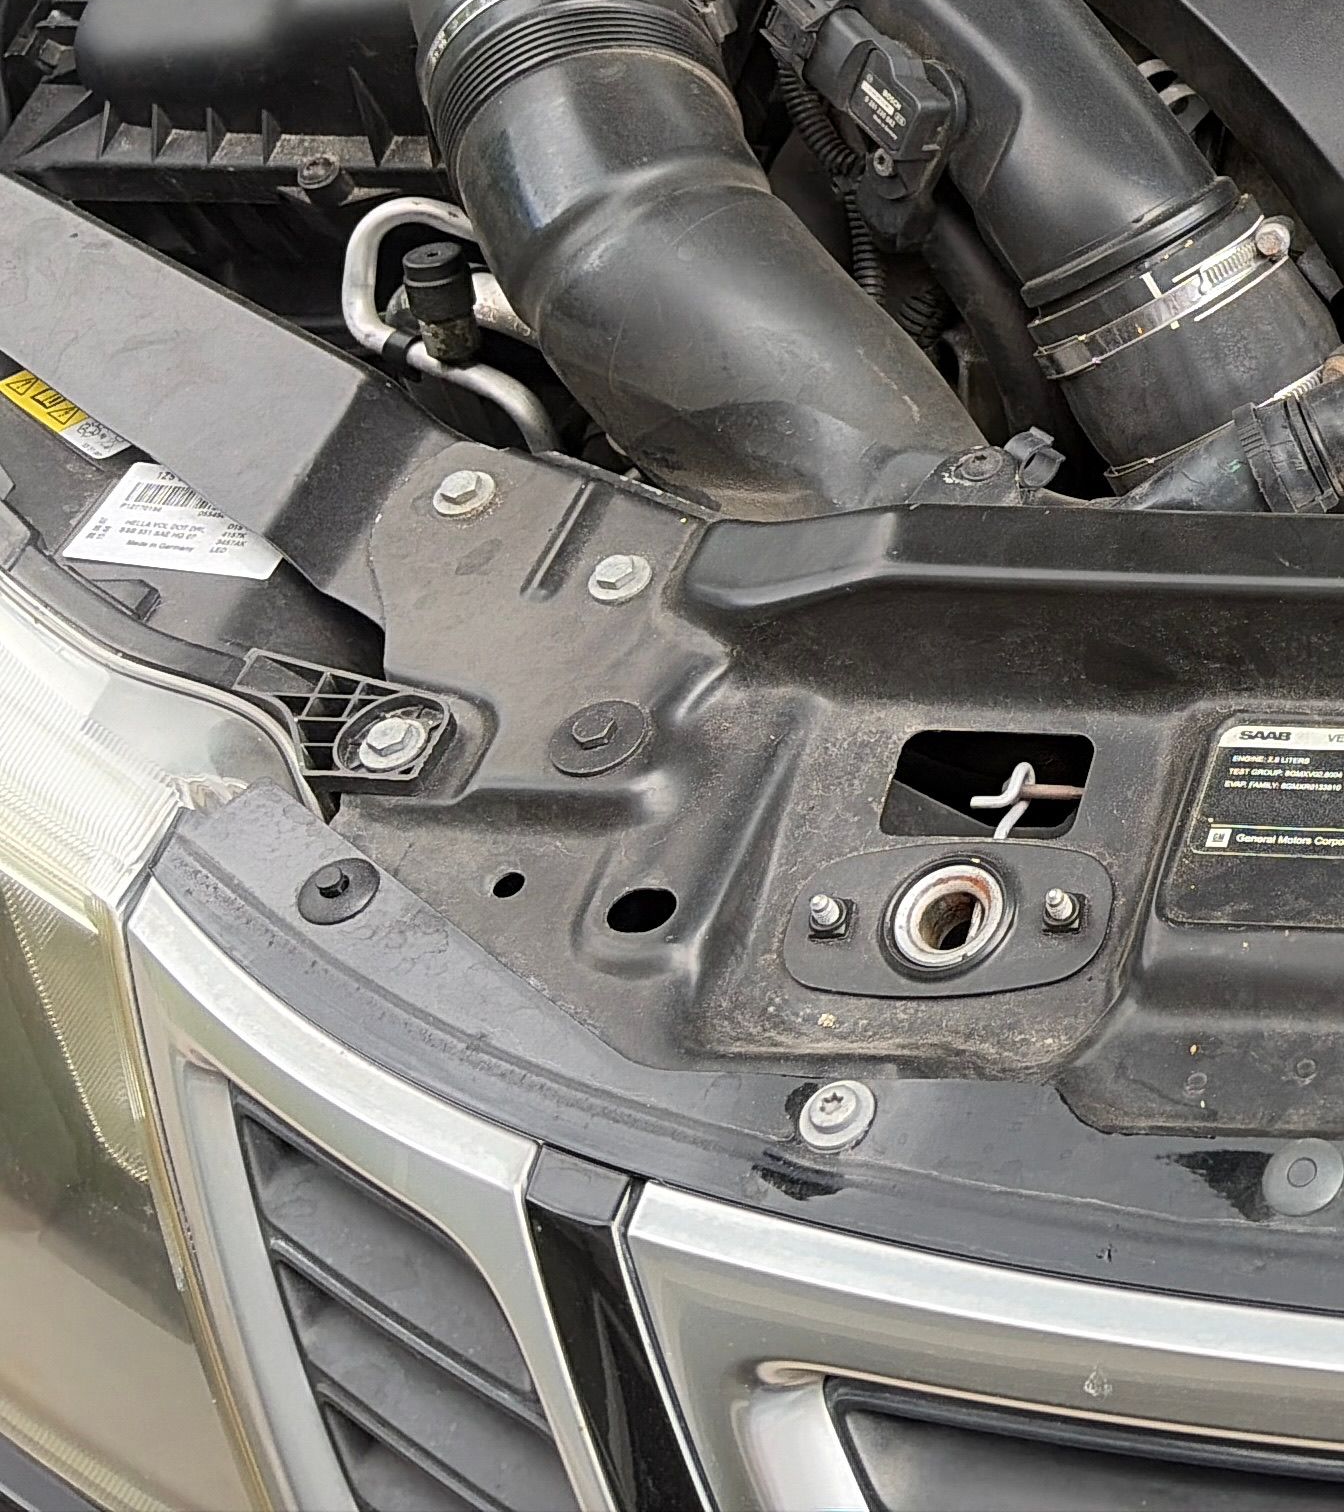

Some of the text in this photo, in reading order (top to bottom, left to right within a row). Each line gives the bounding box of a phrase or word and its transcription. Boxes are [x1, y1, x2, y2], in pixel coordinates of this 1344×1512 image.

[1239, 730, 1292, 742] SAAB
[1236, 833, 1277, 844] General
[1278, 835, 1312, 845] Motors
